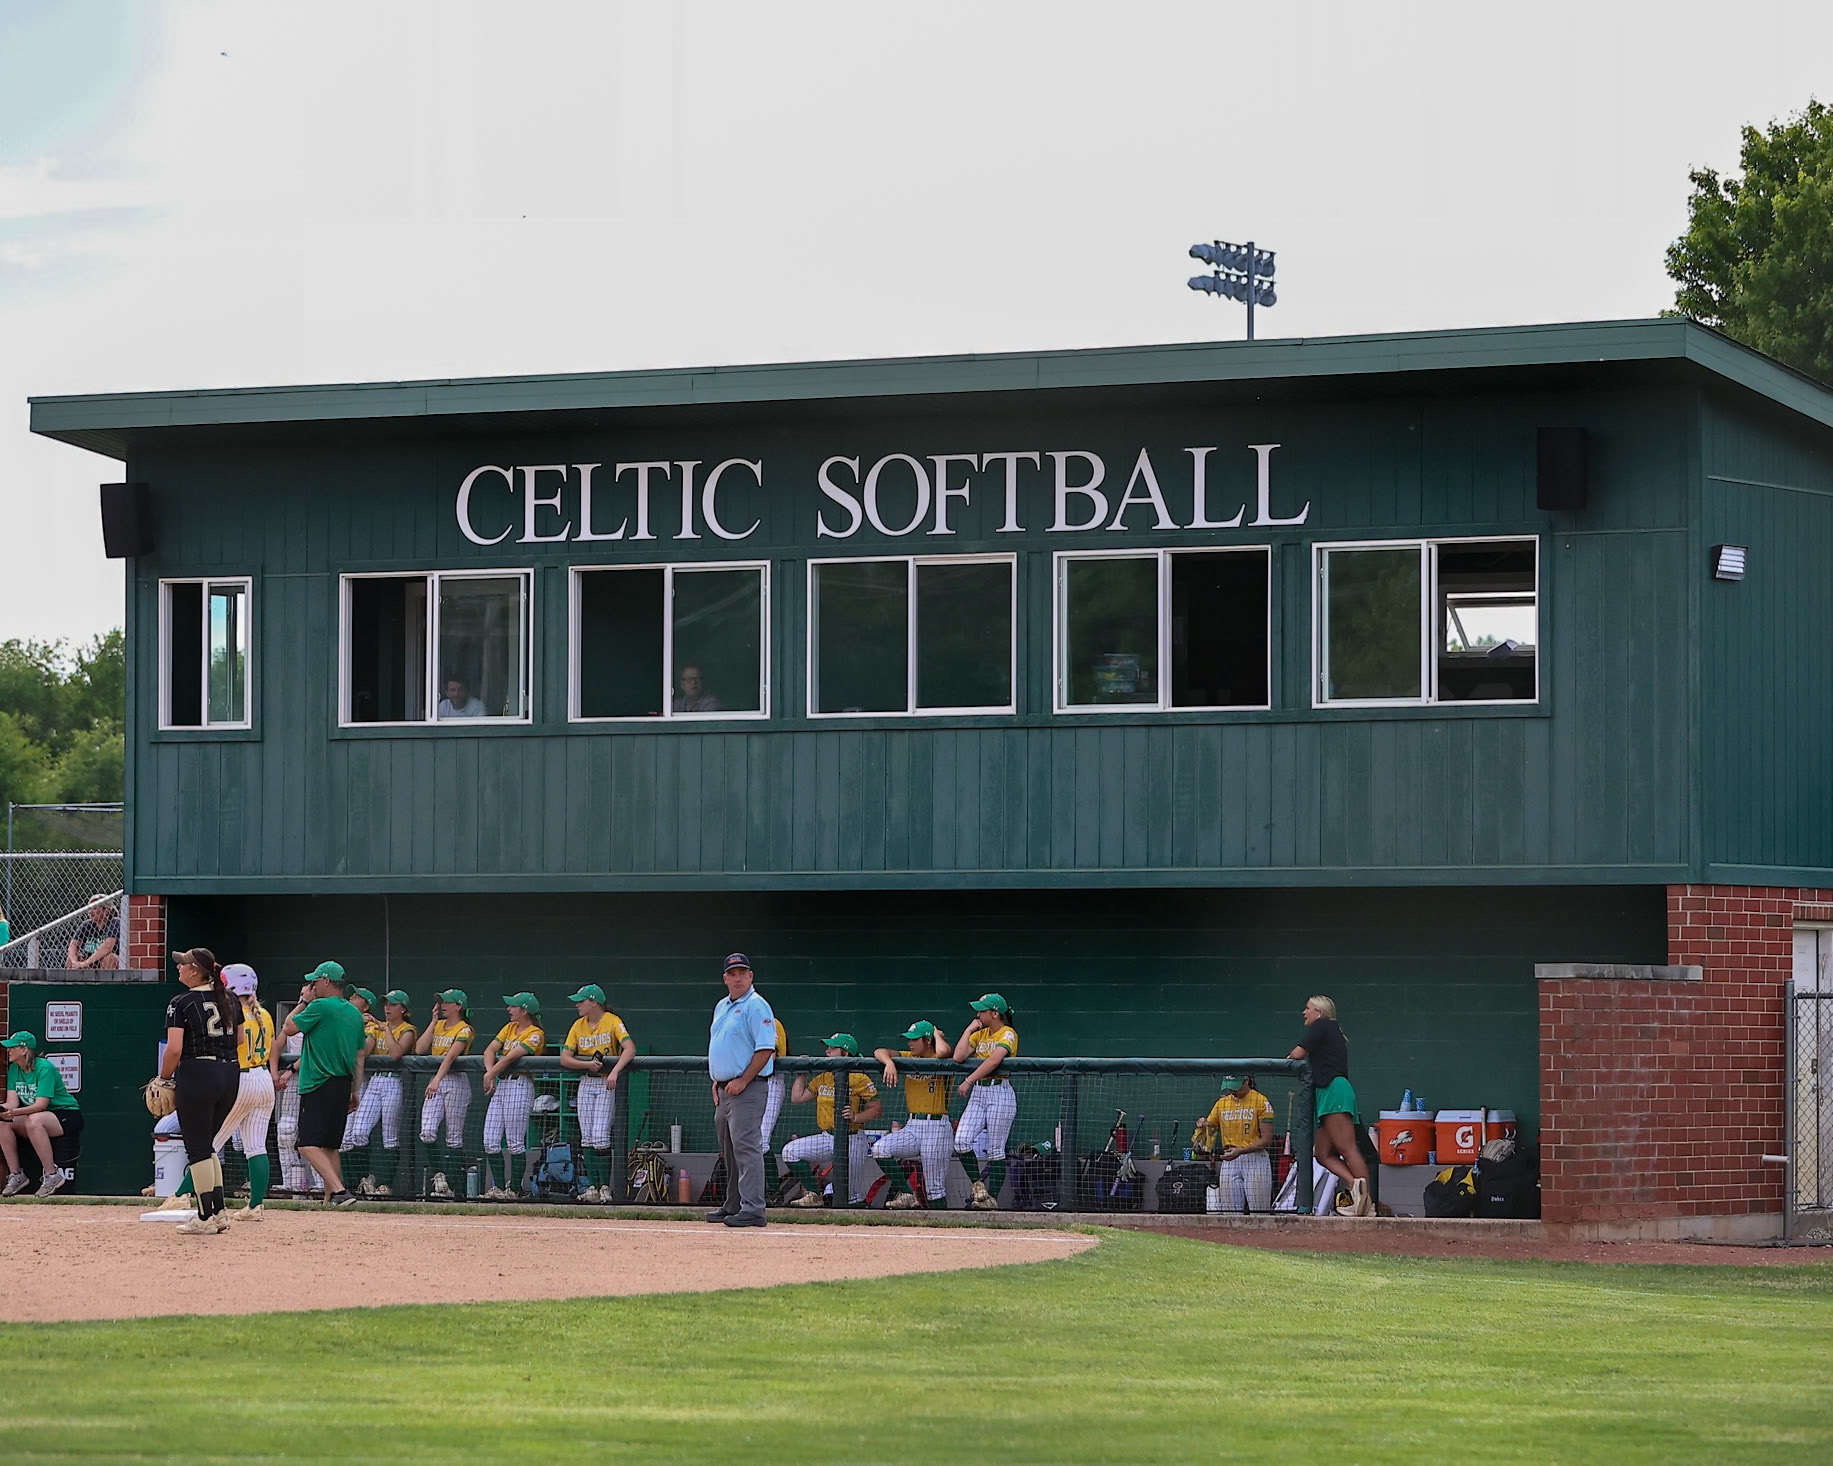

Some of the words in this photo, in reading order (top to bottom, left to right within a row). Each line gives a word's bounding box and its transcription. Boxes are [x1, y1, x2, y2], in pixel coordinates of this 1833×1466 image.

[455, 457, 763, 546] CELTIC
[816, 443, 1311, 539] SOFTBALL
[244, 1027, 267, 1061] 14
[578, 1032, 612, 1048] CELTICS
[1220, 1108, 1254, 1121] CELTICS
[1244, 1123, 1250, 1135] 2
[1455, 1126, 1474, 1148] G
